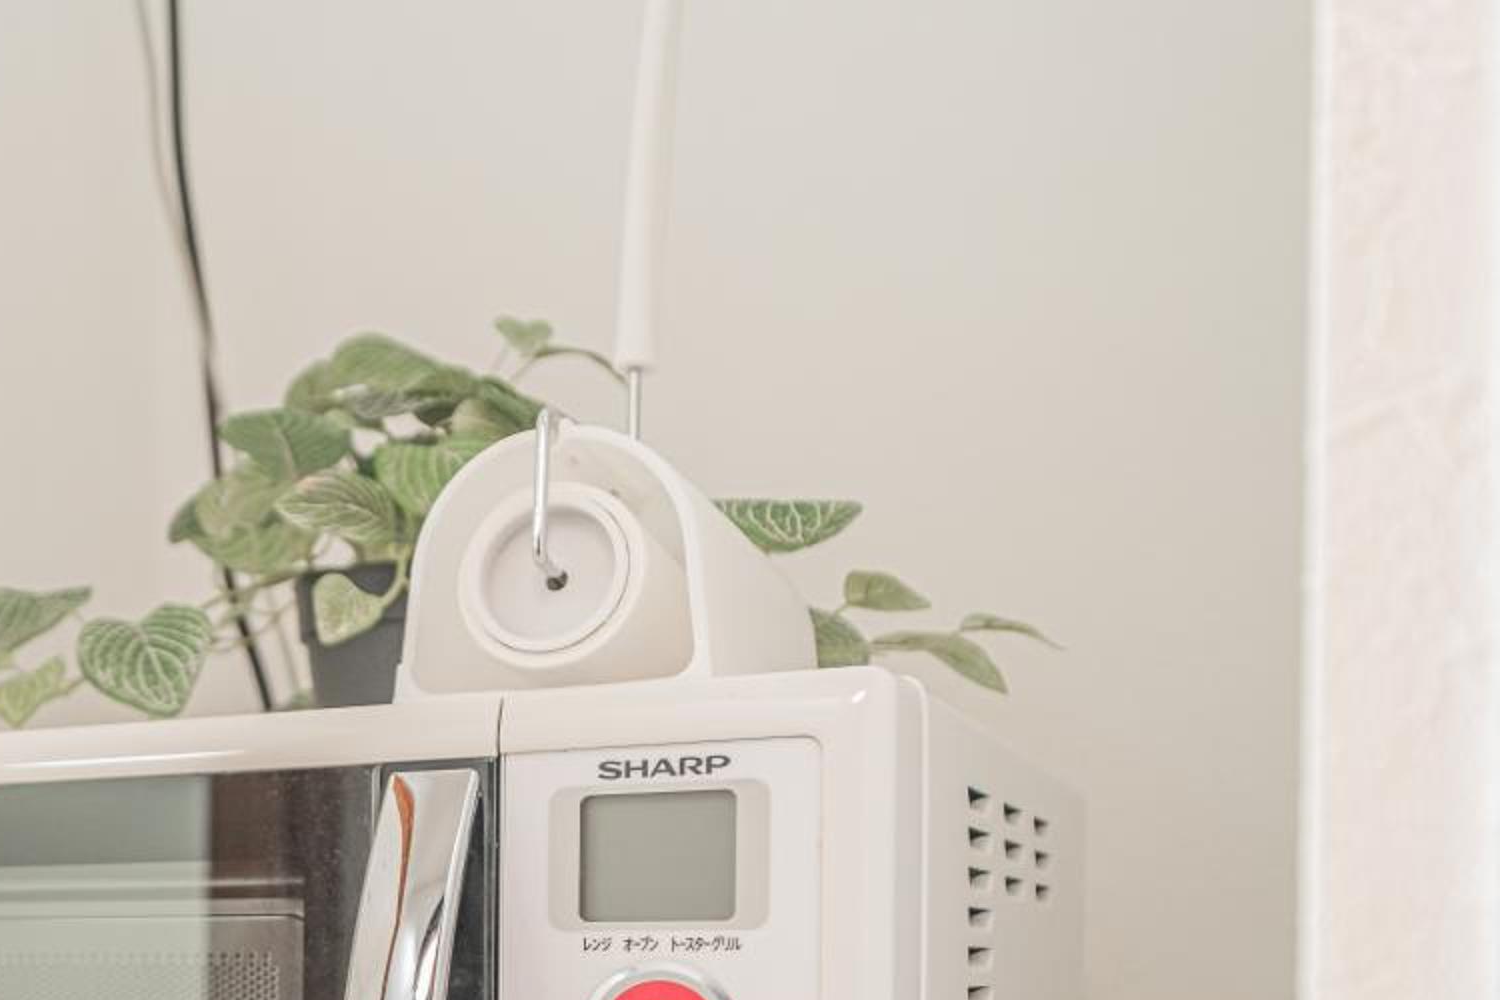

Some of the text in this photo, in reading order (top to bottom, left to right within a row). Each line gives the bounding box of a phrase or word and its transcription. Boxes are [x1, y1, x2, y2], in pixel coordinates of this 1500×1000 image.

[598, 755, 731, 780] SHARP
[583, 936, 612, 952] レンジ
[623, 935, 659, 953] オープン
